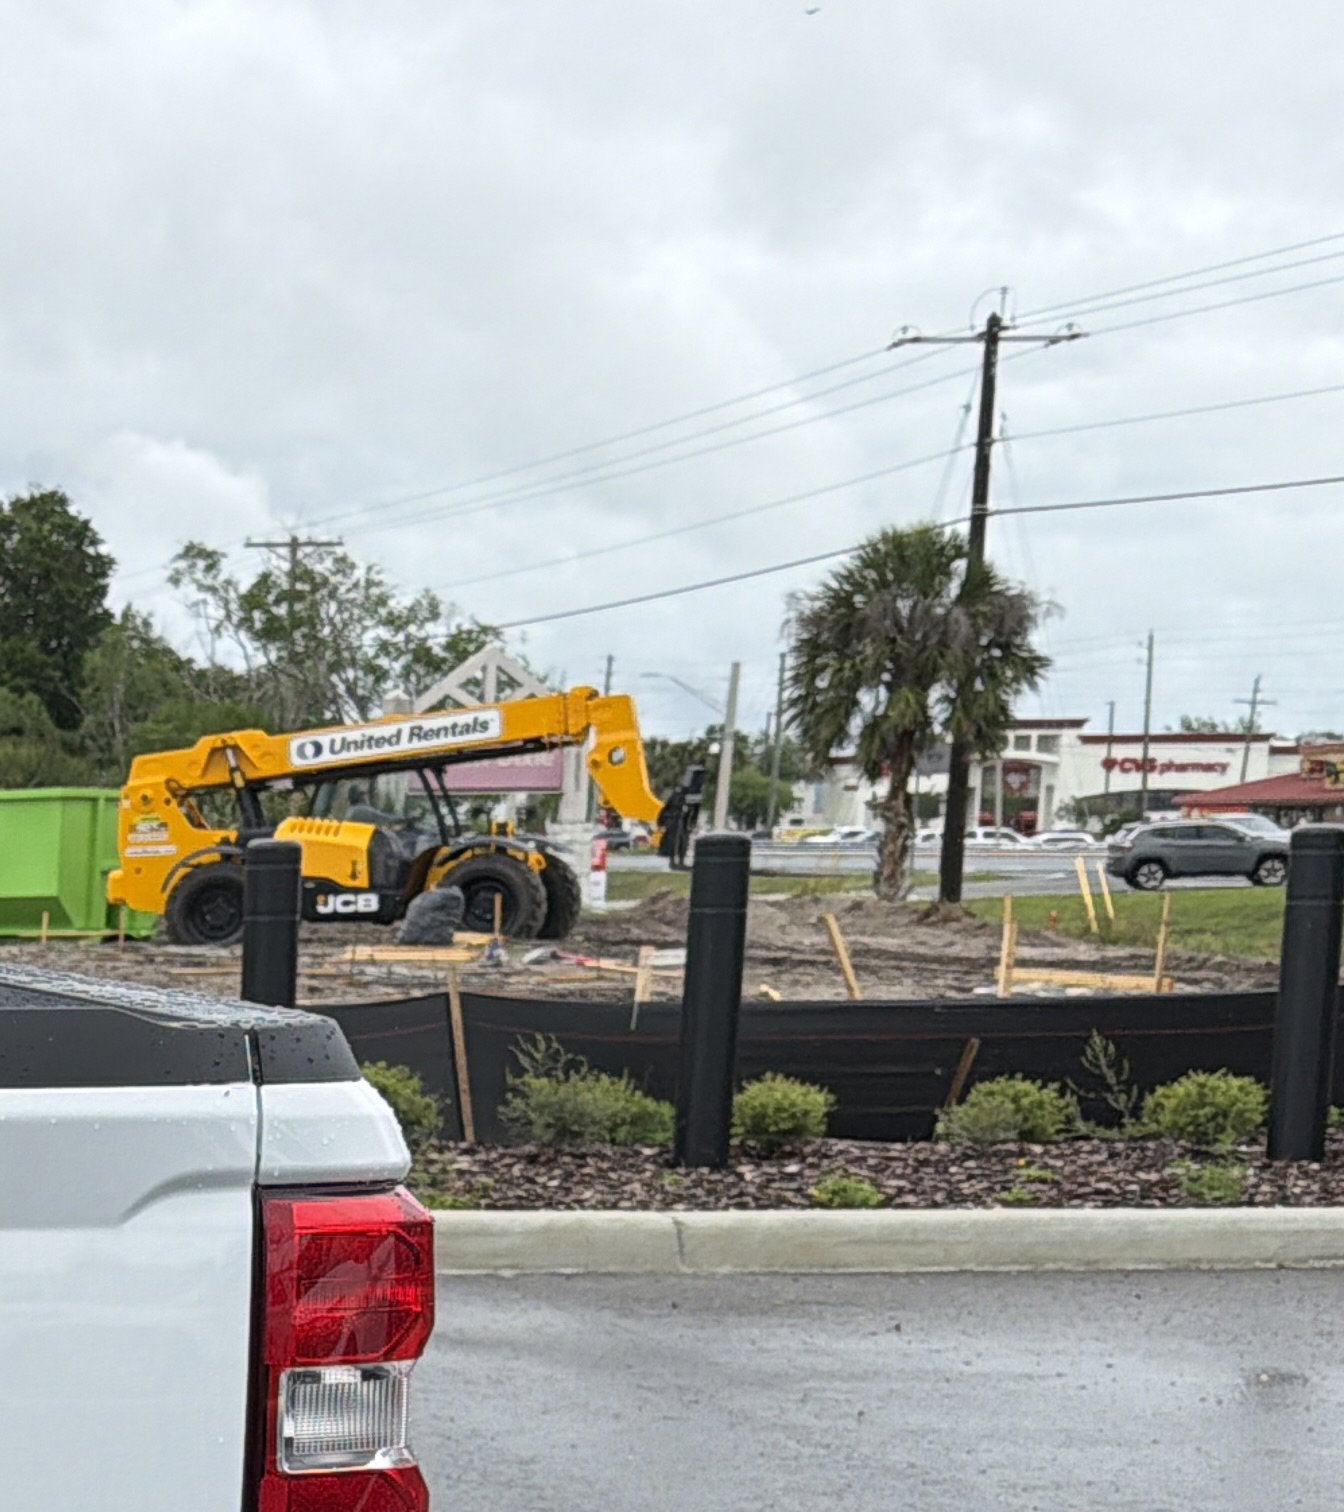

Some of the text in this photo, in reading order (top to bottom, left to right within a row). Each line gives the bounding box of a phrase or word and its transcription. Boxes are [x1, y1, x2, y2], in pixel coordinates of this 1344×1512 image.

[328, 715, 490, 756] United Rentals
[1118, 757, 1230, 776] CVS pharmacy
[315, 892, 380, 915] JCB
